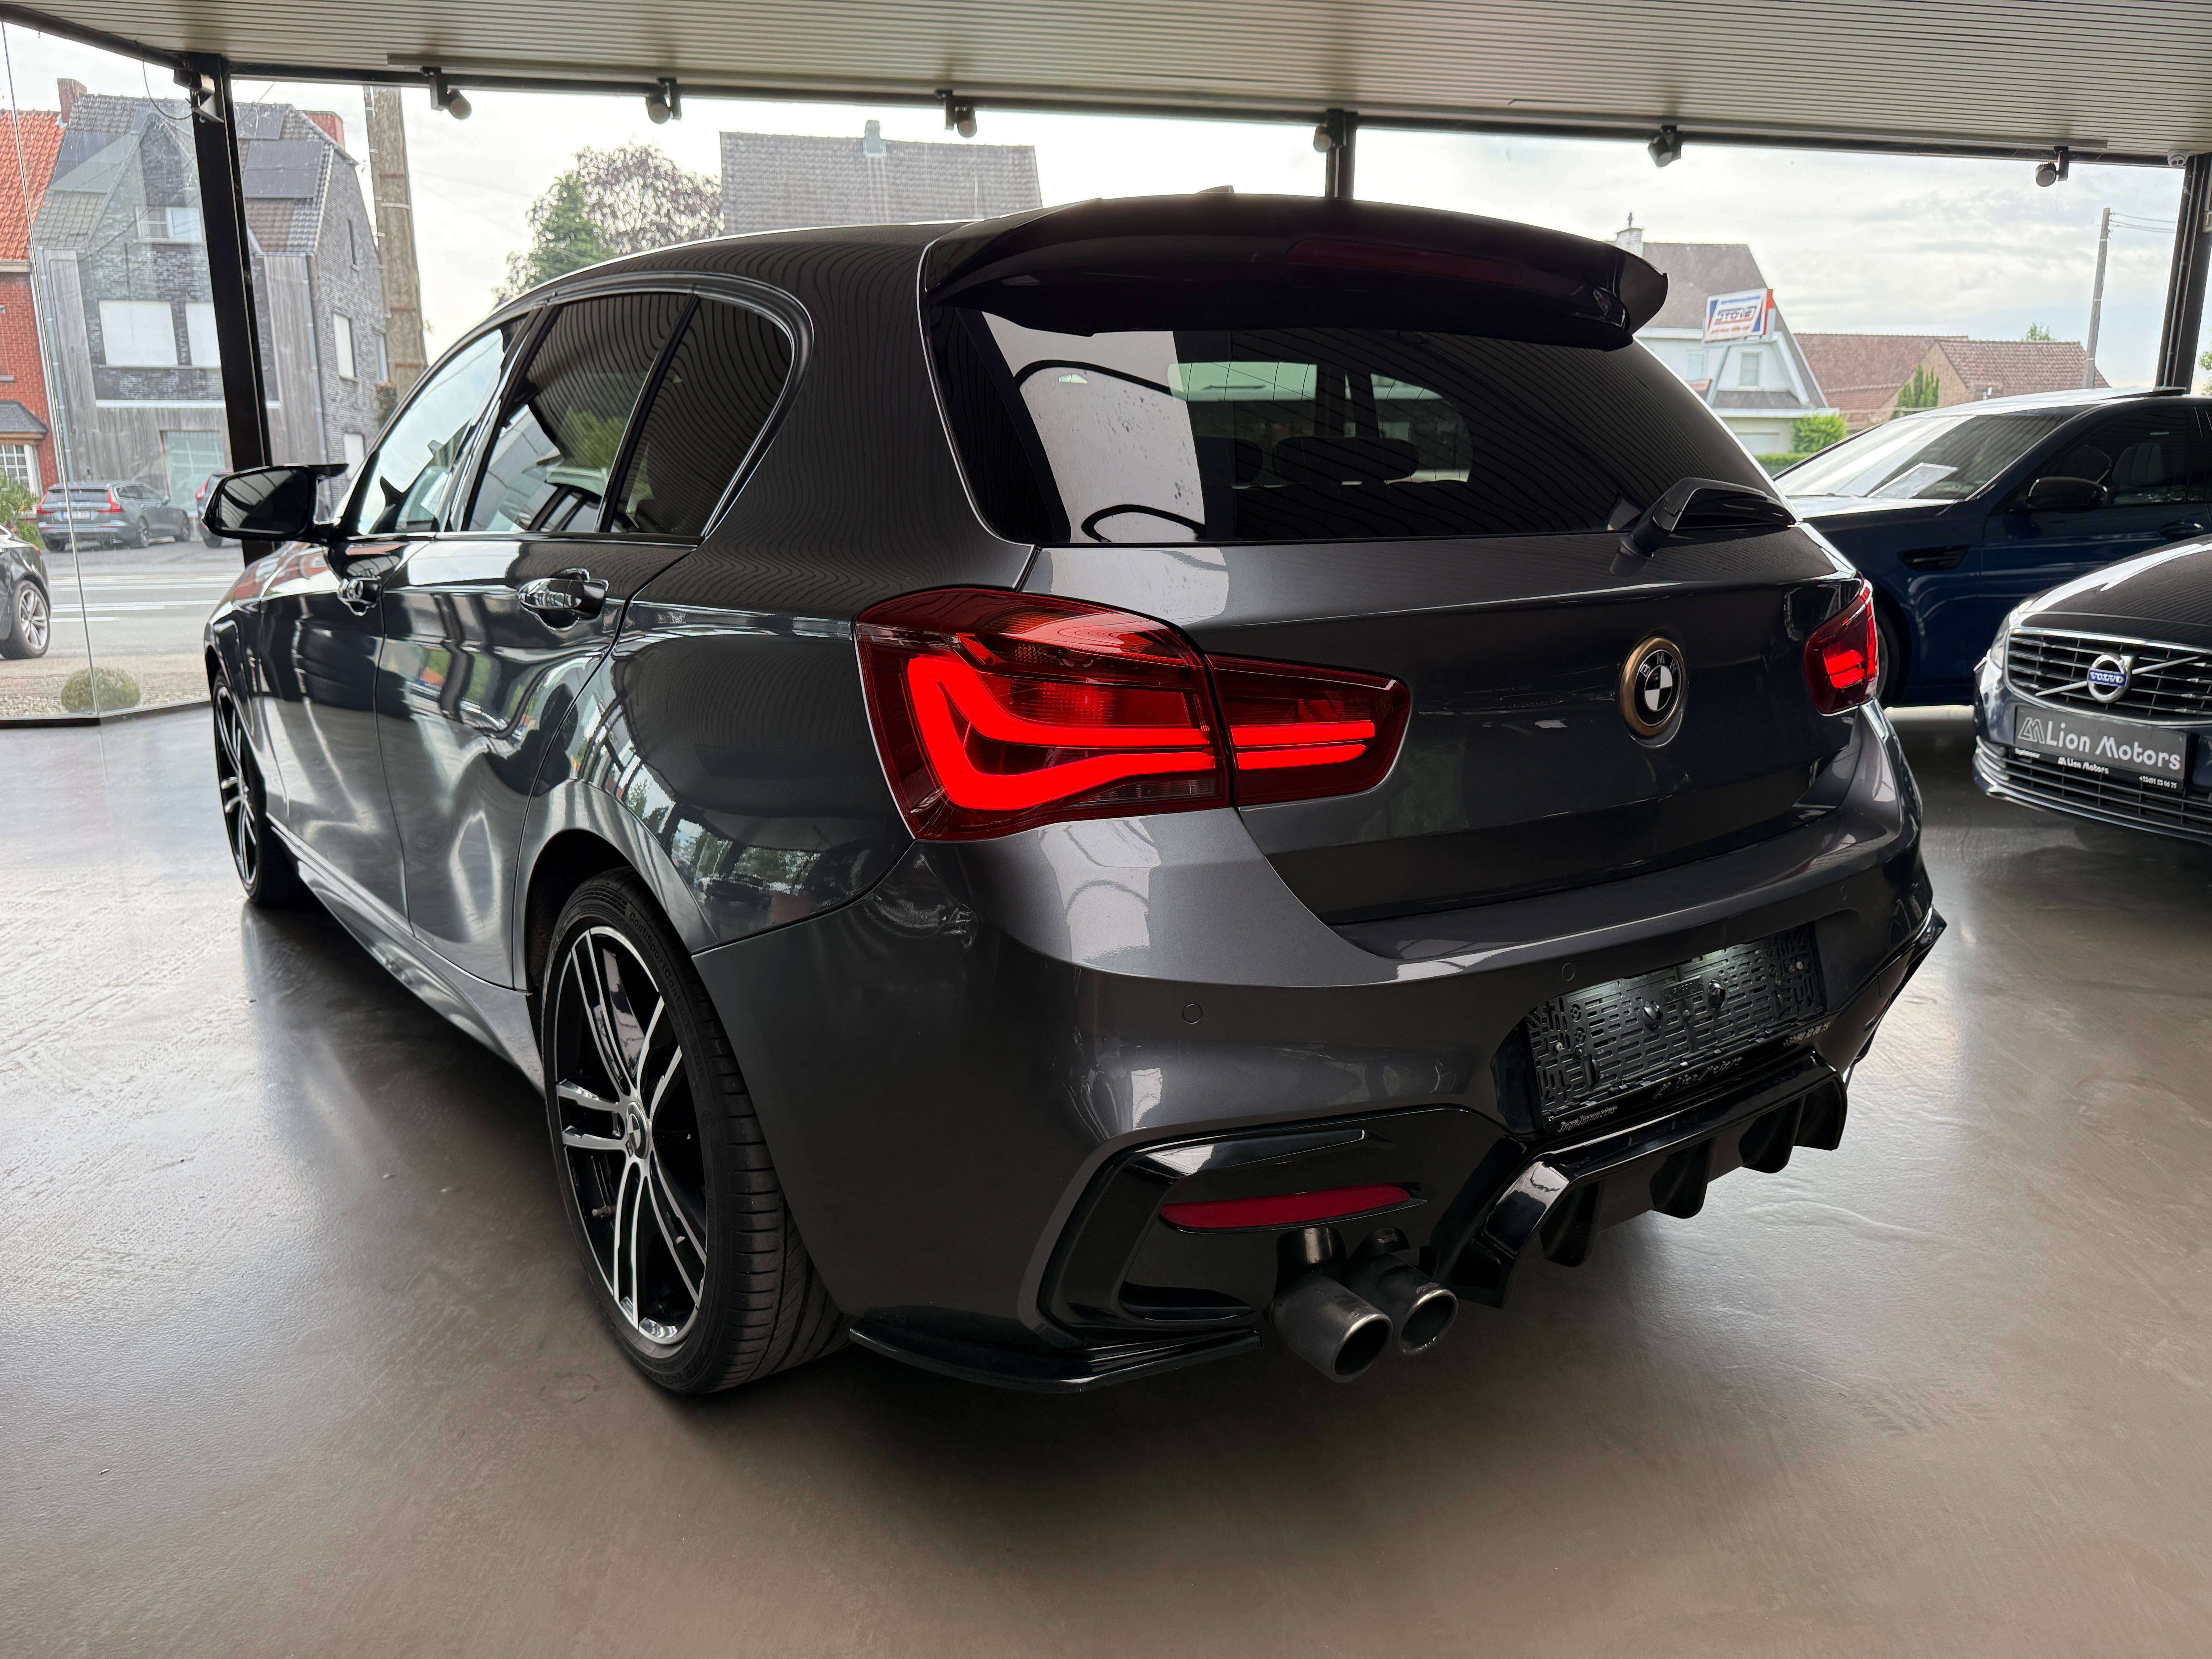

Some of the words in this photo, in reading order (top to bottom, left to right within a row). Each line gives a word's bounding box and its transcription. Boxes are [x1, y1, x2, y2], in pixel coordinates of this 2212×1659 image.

[1640, 652, 1677, 677] BMW
[2090, 672, 2124, 683] VOLVO
[2046, 721, 2090, 752] Lion
[2095, 736, 2180, 770] Motors
[2067, 757, 2081, 769] Lion
[2082, 762, 2109, 774] Motors
[629, 912, 689, 1030] ContiSportContact
